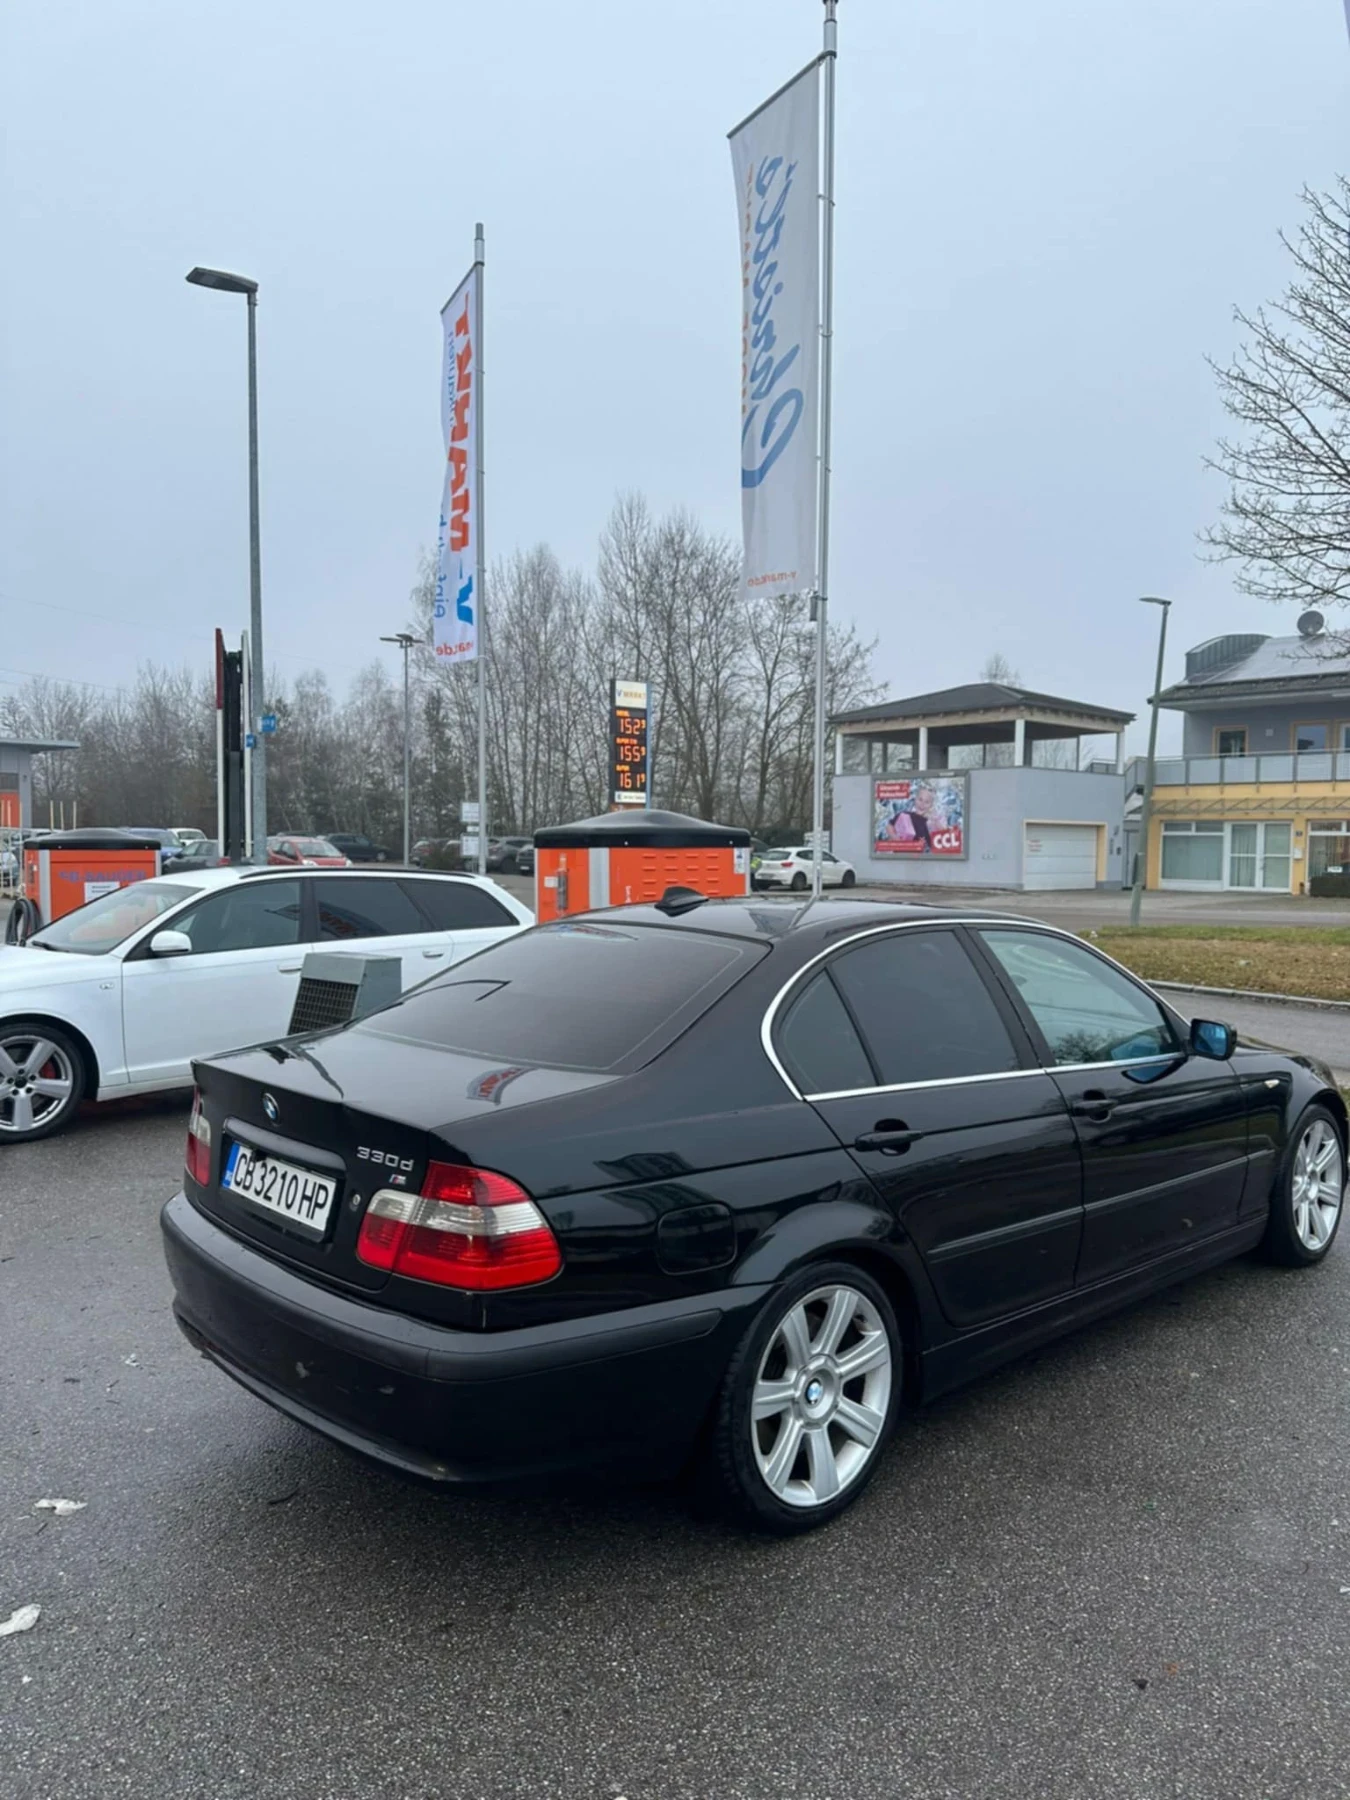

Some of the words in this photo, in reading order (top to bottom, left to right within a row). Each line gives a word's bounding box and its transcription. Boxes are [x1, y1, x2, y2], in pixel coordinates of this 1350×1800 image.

[933, 832, 960, 849] CCL
[356, 1145, 415, 1172] 330d
[254, 1161, 299, 1210] 3210
[297, 1178, 329, 1220] HP
